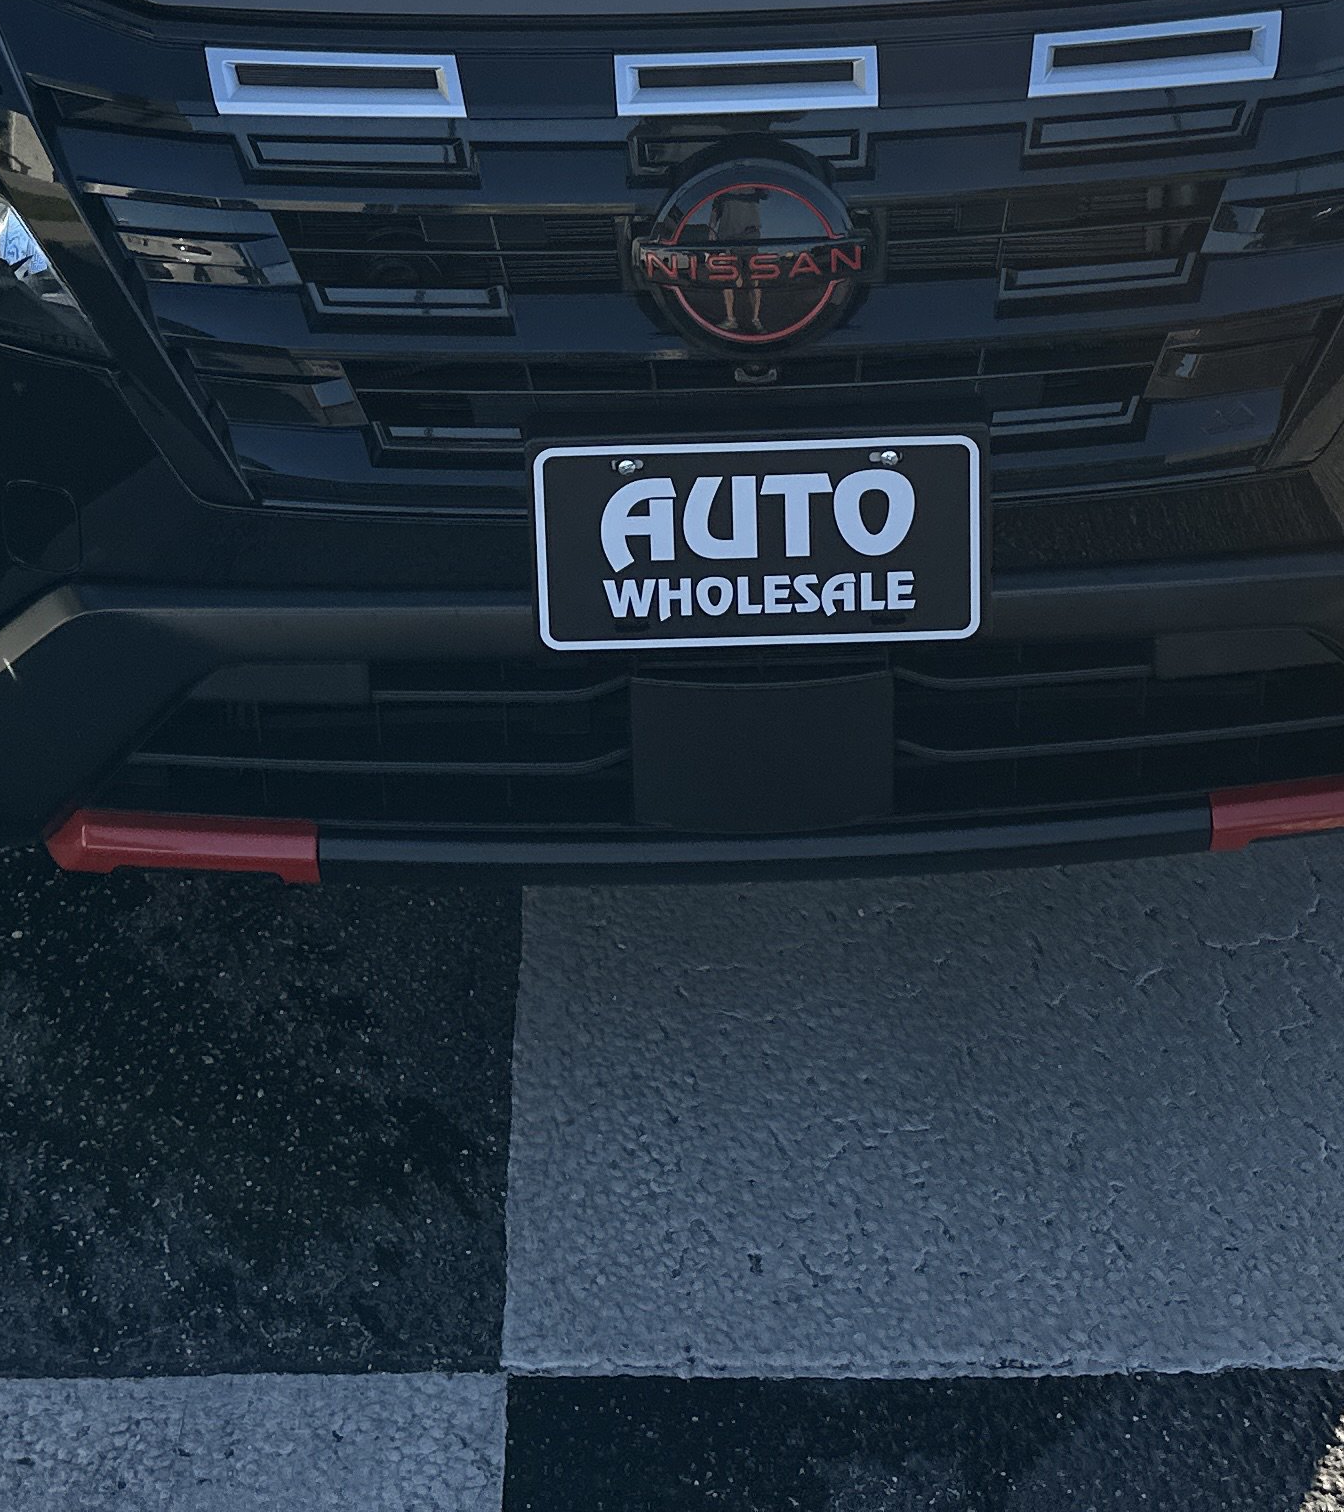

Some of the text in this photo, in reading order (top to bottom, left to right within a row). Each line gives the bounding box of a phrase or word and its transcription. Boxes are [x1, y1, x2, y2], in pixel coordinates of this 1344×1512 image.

[645, 245, 864, 282] NISSAN
[600, 469, 916, 573] AUTO
[602, 570, 917, 622] WHOLESALE
